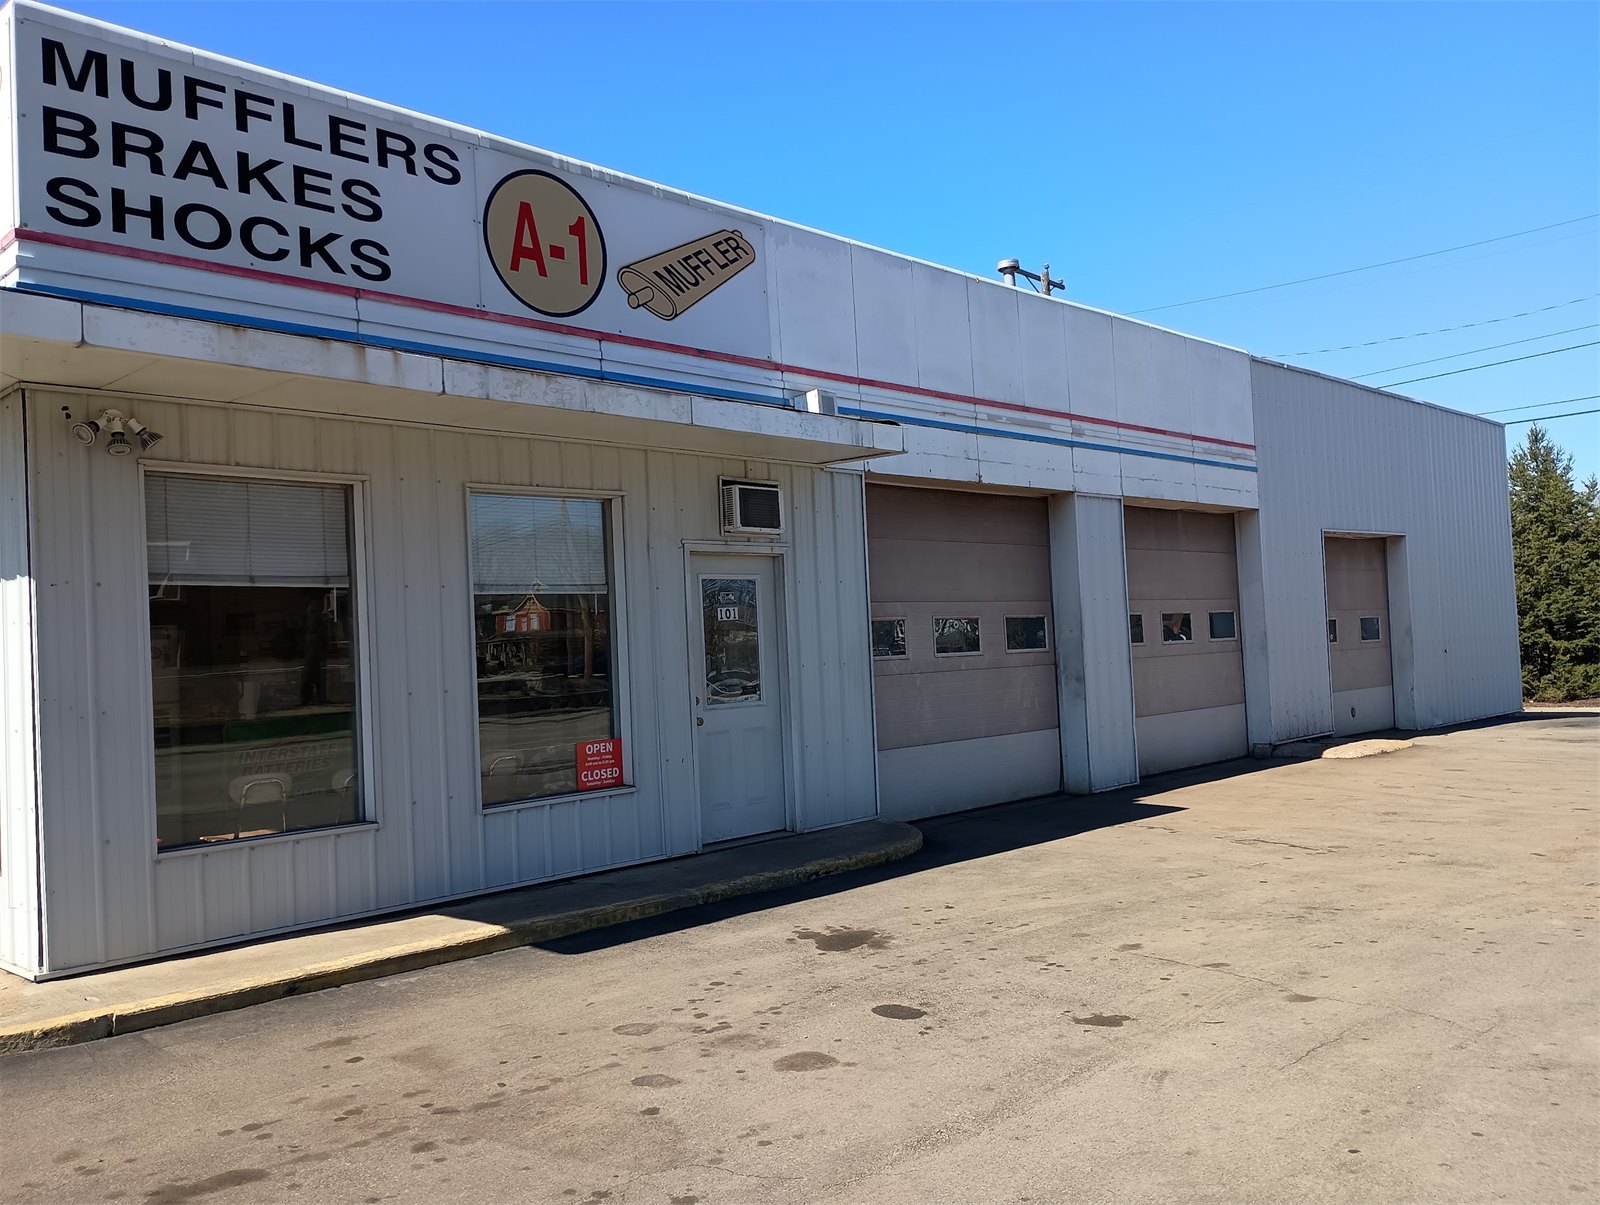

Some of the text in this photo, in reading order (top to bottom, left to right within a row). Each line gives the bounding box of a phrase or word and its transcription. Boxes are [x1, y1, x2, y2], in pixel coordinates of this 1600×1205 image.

[41, 36, 462, 186] MUFFLERS
[42, 105, 383, 223] BRAKES
[45, 176, 392, 282] SHOCKS
[509, 200, 589, 286] A-1
[652, 236, 750, 297] MUFFLER
[719, 608, 737, 620] 101
[581, 767, 620, 782] CLOSED
[586, 742, 613, 754] OPEN
